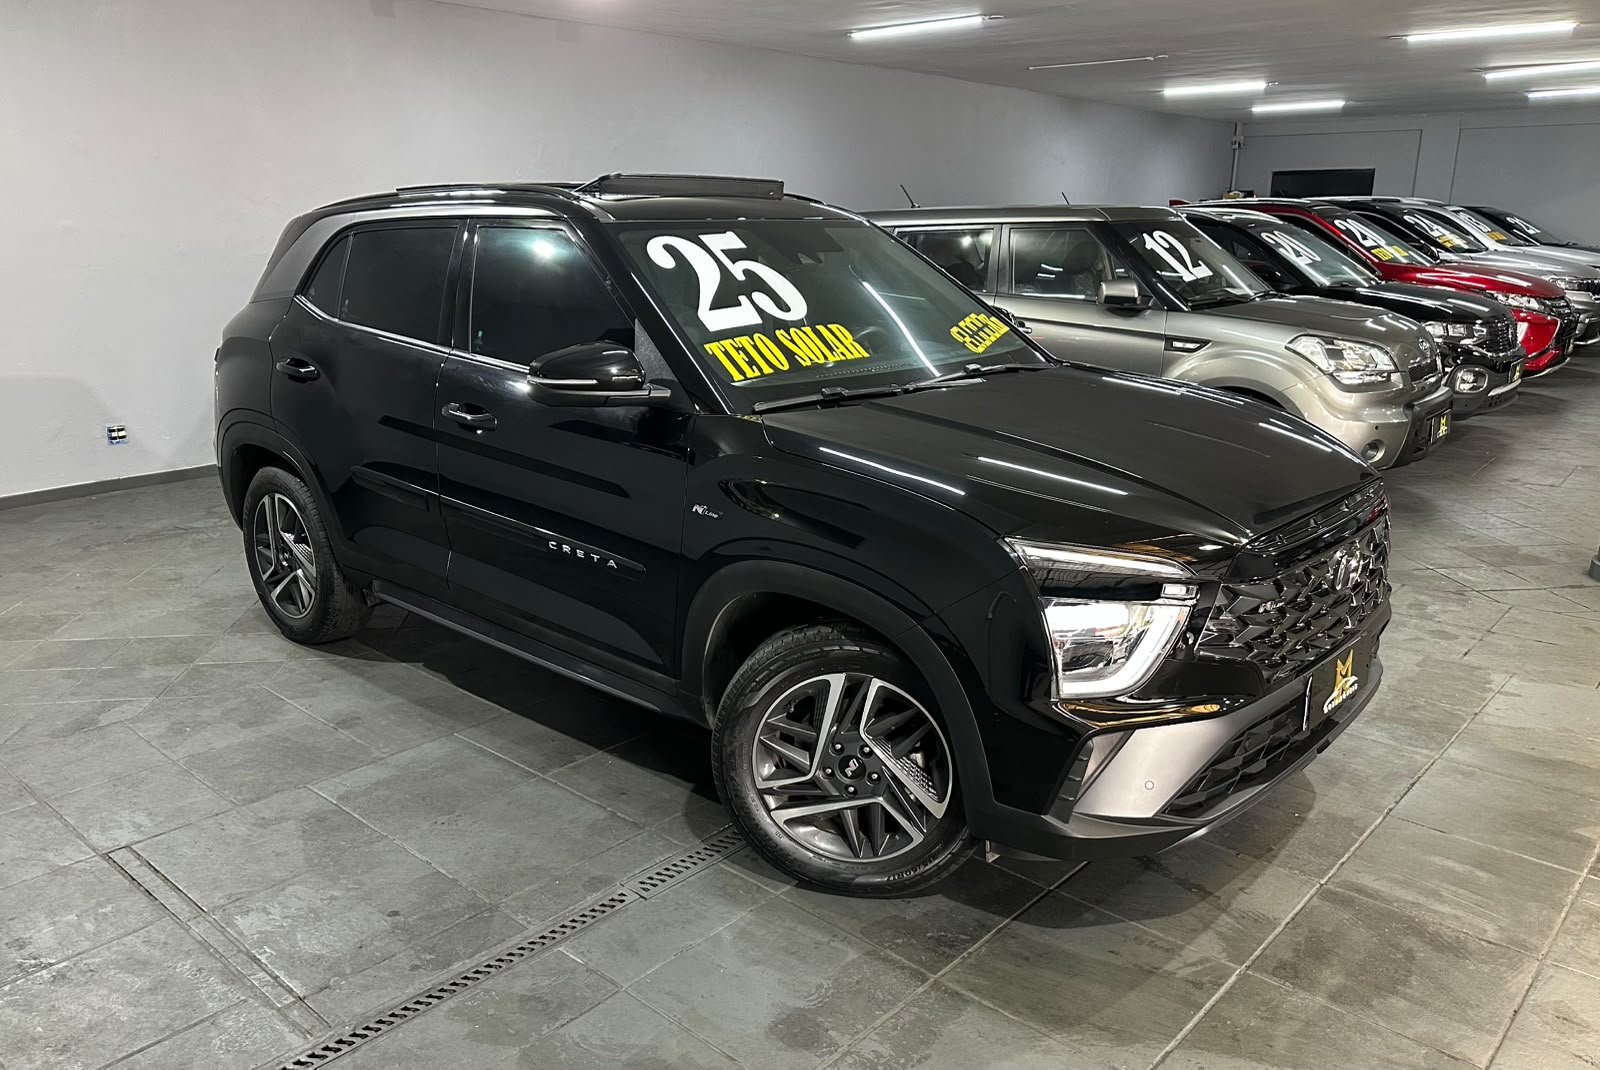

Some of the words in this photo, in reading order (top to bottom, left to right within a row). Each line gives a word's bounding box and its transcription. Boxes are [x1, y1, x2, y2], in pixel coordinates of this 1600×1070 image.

[646, 230, 809, 332] 25
[1143, 230, 1213, 282] 12
[704, 331, 788, 382] TETO
[779, 323, 870, 367] SOLAR
[548, 541, 618, 569] CRETA
